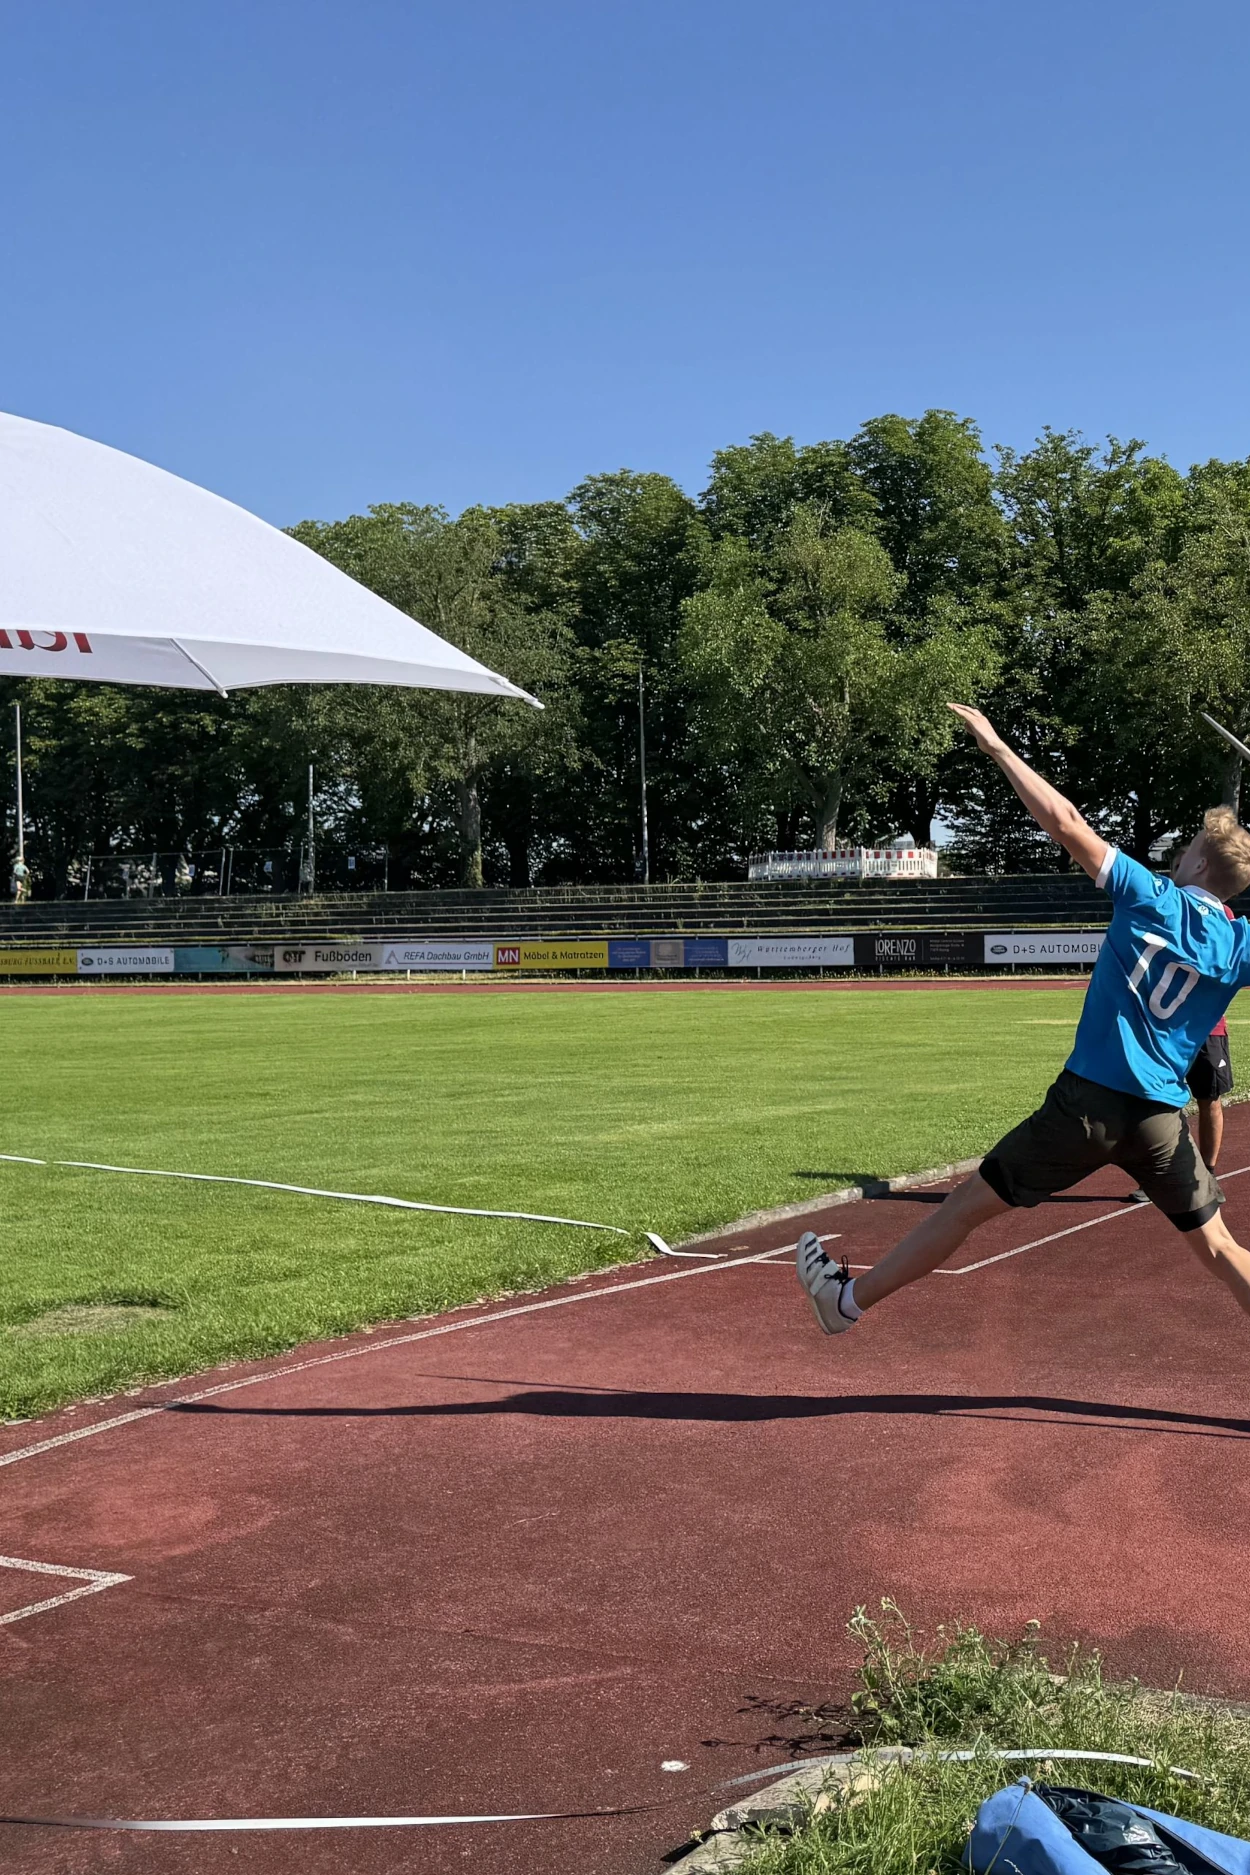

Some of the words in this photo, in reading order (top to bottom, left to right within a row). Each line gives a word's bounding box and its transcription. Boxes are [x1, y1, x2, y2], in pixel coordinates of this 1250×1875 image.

[875, 939, 916, 956] LORENZO
[1013, 944, 1036, 954] D+S
[116, 957, 170, 965] AUTOMOBILE
[315, 950, 372, 962] Fußböden
[403, 951, 425, 961] REFA
[426, 950, 461, 961] Dachbau
[464, 950, 490, 960] GmbH
[497, 949, 519, 963] MN
[523, 951, 549, 961] Möbel
[551, 951, 558, 961] &
[560, 950, 604, 960] Matratzen
[1125, 931, 1201, 1020] 10
